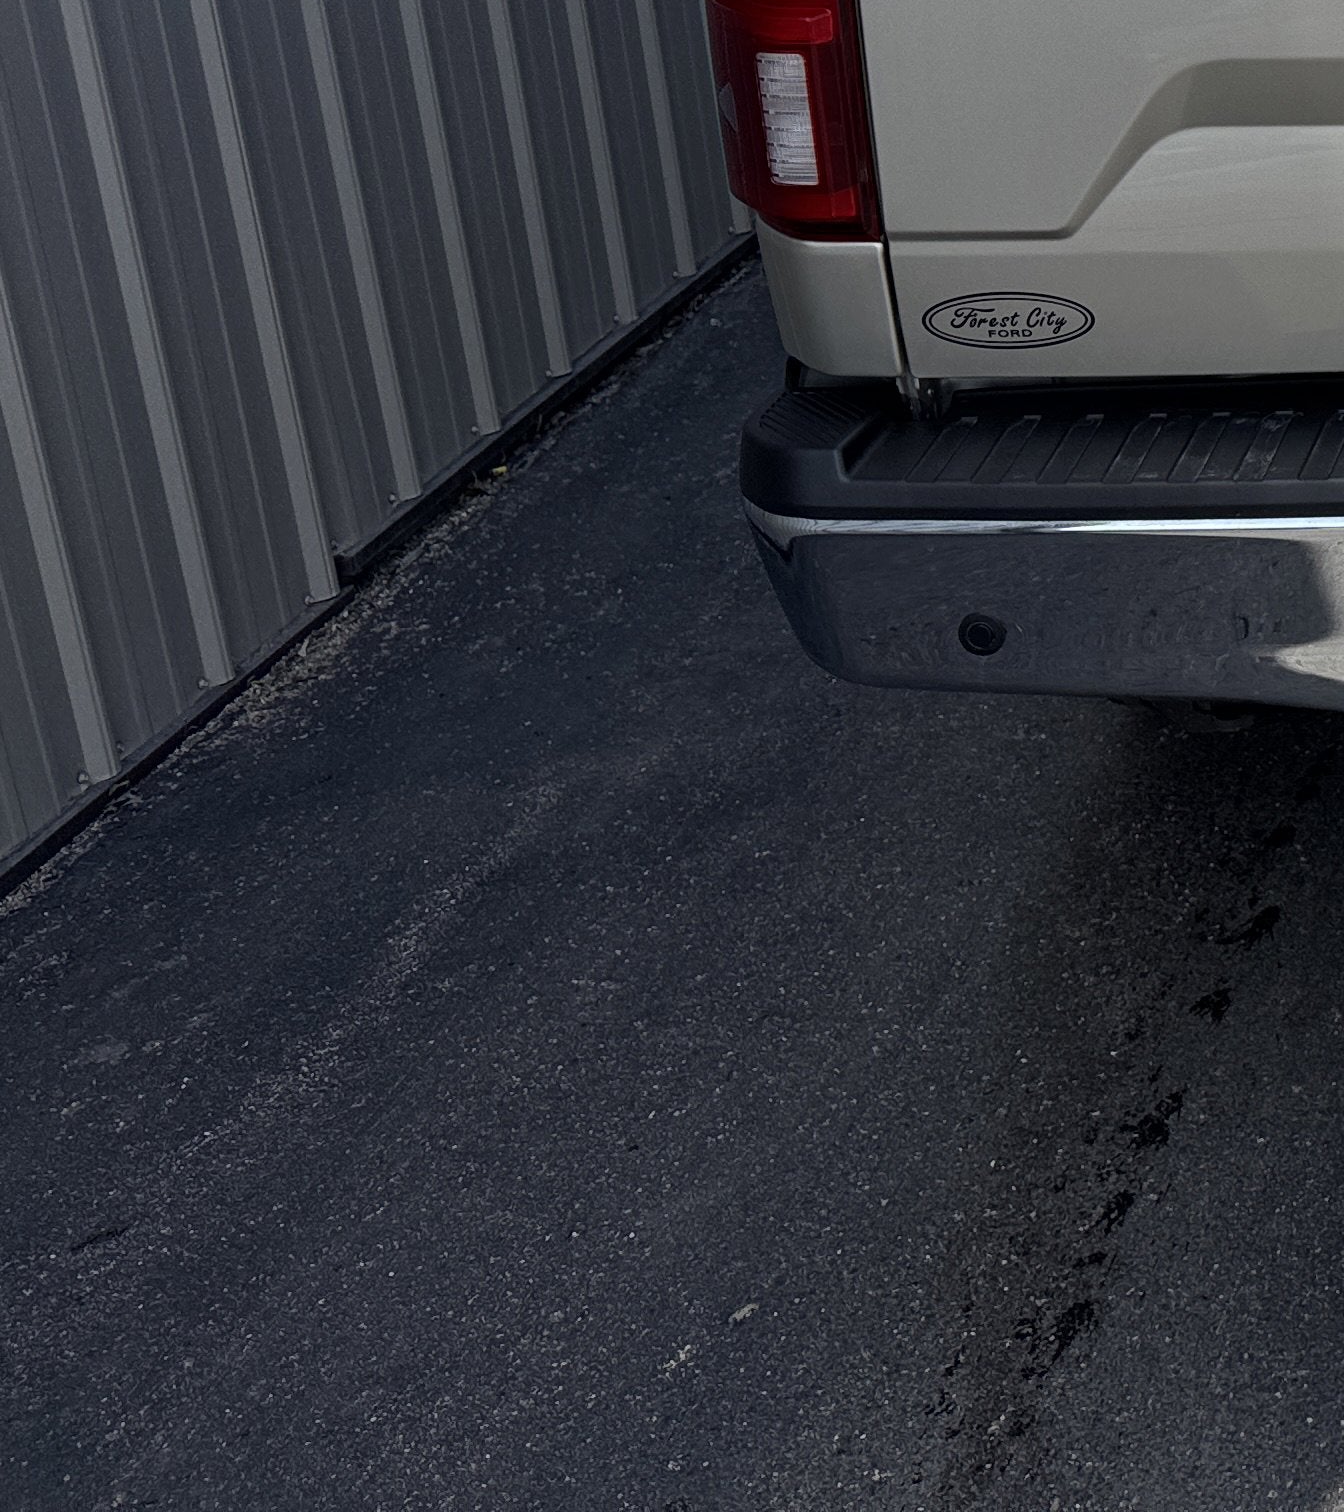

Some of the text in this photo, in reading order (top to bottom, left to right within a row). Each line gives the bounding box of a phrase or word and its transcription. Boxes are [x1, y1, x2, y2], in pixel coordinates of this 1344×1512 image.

[950, 307, 1068, 334] Forest City
[987, 329, 1033, 338] FORD
